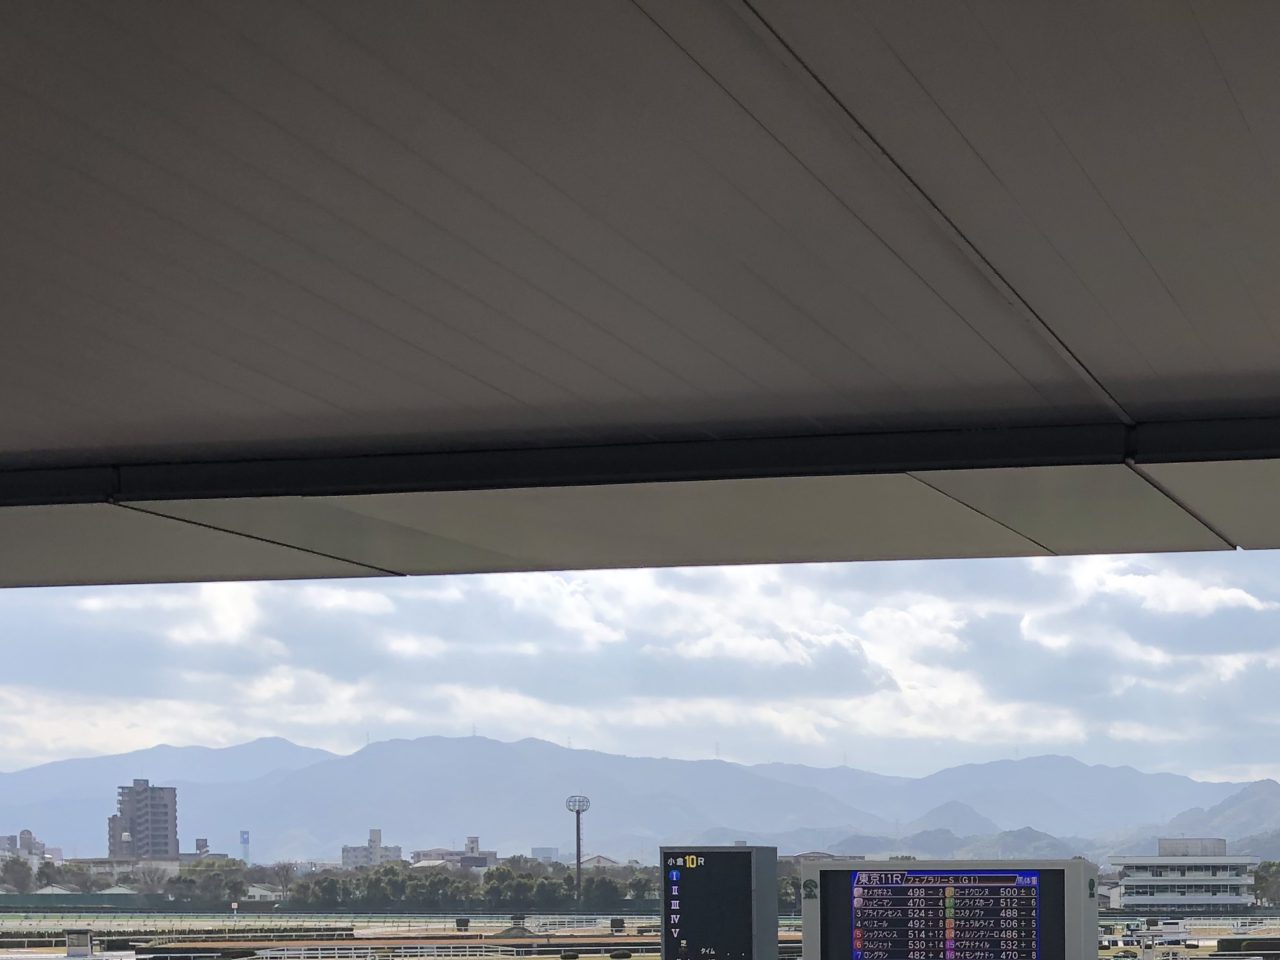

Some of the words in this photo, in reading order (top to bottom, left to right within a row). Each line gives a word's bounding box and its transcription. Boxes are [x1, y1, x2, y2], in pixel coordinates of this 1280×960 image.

[858, 873, 902, 885] 東京11R
[1000, 888, 1018, 896] 500
[1000, 899, 1018, 907] 512
[1000, 909, 1018, 917] 488
[908, 920, 925, 928] 492
[1000, 920, 1018, 928] 506
[908, 941, 926, 949] 530
[1000, 941, 1018, 949] 532
